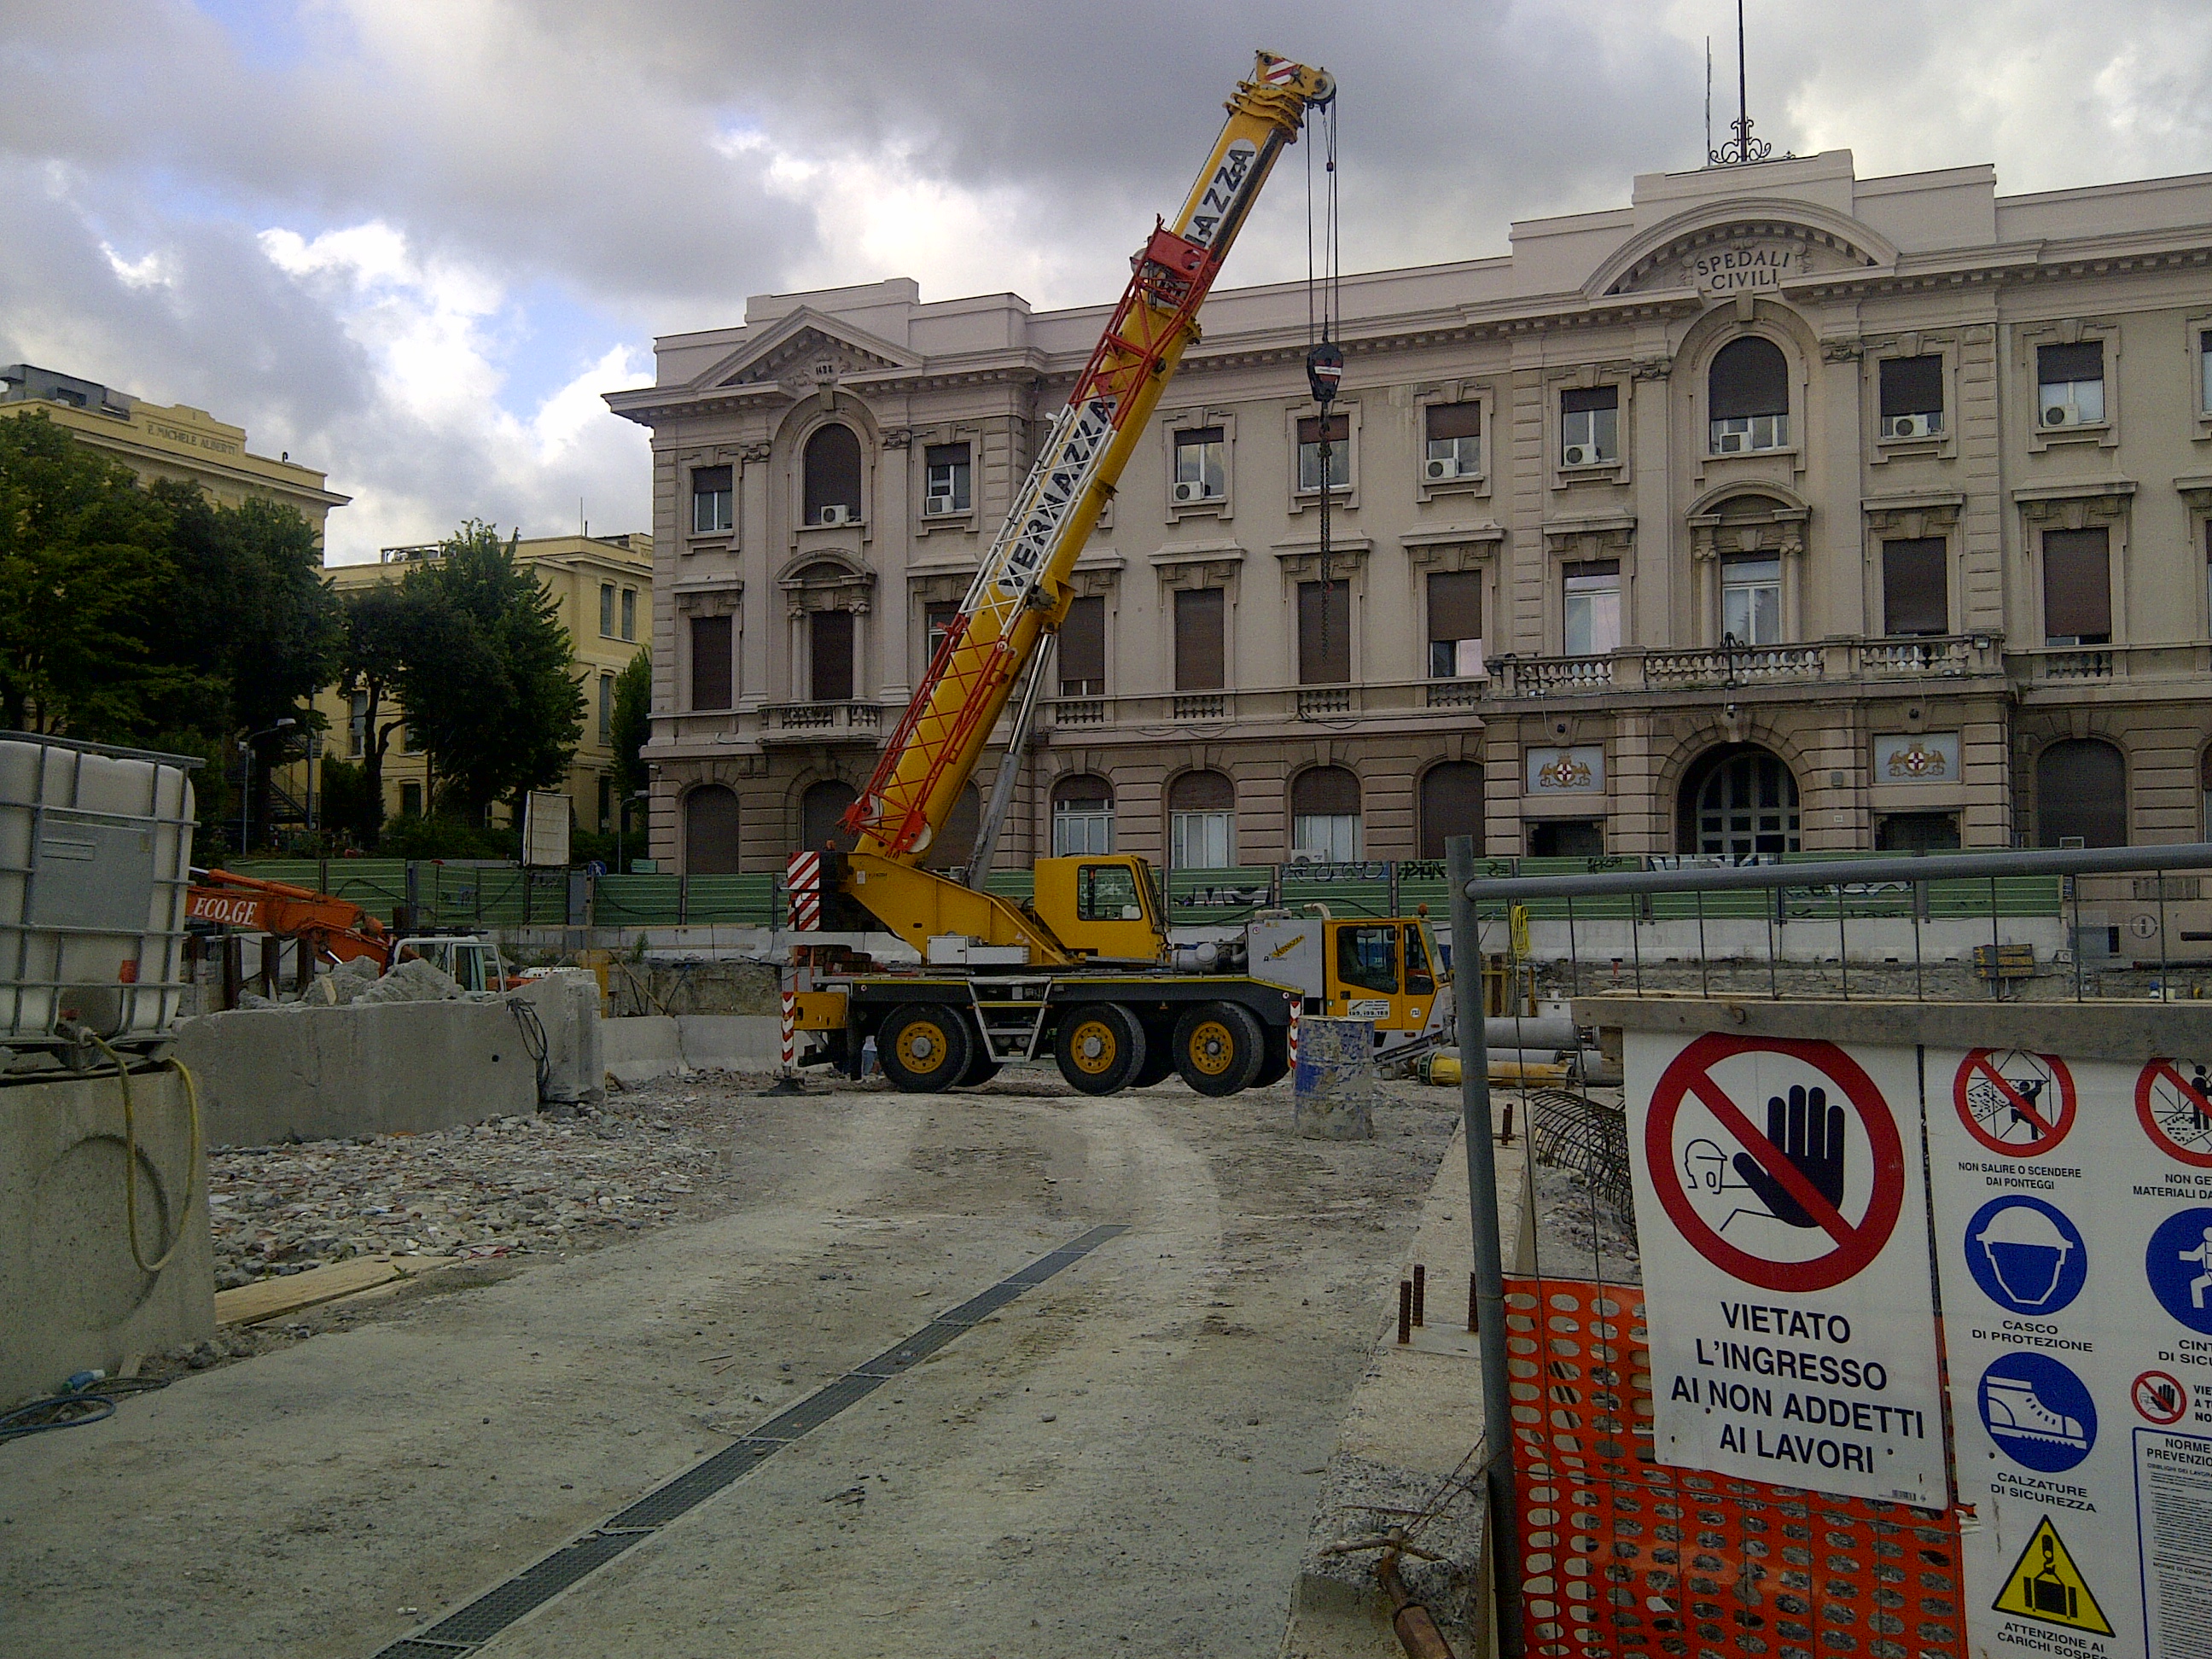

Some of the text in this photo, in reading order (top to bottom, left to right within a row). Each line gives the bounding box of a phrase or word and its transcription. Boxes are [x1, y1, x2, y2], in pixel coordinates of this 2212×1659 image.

[1697, 250, 1790, 276] SPEDALI
[1711, 269, 1778, 289] CIVILI
[998, 401, 1116, 587] VERNAZZA
[193, 897, 258, 926] ECO.GE
[1959, 1161, 2081, 1179] NON SALIRE O SCENDERE
[2165, 1173, 2212, 1186] NON GE
[1986, 1176, 2055, 1190] DAI PONTEGGI
[2133, 1185, 2196, 1199] MATERIALI
[1720, 1301, 1850, 1344] VIETATO
[2002, 1320, 2058, 1335] CASCO
[1971, 1329, 2093, 1353] DI PROTEZIONE
[1696, 1337, 1888, 1391] L'INGRESSO
[2158, 1351, 2174, 1362] DI
[2193, 1385, 2212, 1396] VIE
[1671, 1375, 1924, 1439] AI NON ADDETTI
[2194, 1399, 2202, 1408] A
[1720, 1423, 1874, 1474] AI LAVORI
[2165, 1438, 2211, 1453] NORME
[1997, 1472, 2088, 1498] CALZATURE
[1990, 1483, 2097, 1513] DI SICUREZZA
[1997, 1632, 2051, 1652] CARICHI
[2005, 1621, 2104, 1653] ATTENZIONE AI
